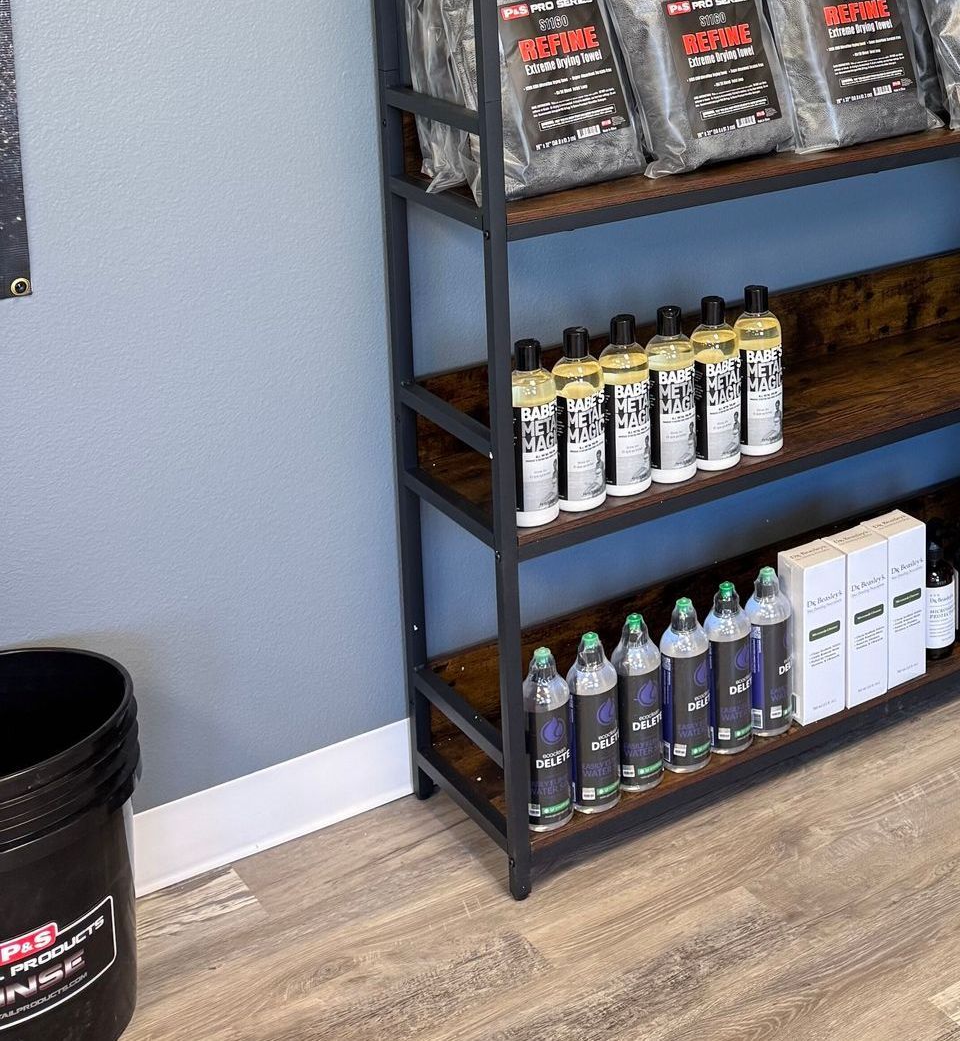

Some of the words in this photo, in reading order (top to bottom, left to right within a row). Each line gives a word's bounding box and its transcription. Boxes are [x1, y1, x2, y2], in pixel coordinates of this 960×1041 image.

[503, 6, 528, 17] P&S
[530, 2, 554, 14] PRO
[669, 2, 690, 14] P&S
[692, 0, 713, 10] PRO
[828, 26, 855, 38] Extreme
[856, 22, 876, 34] Drying
[876, 19, 893, 30] Towel
[518, 26, 599, 62] REFINE
[682, 24, 752, 55] REFINE
[525, 60, 556, 76] Extreme
[557, 53, 580, 69] Drying
[581, 50, 602, 64] Towel
[688, 53, 715, 68] Extreme
[715, 50, 737, 63] Drying
[738, 46, 754, 57] Towel
[747, 360, 782, 378] METAL
[706, 372, 741, 392] METAL
[748, 374, 783, 392] MAGIC
[707, 383, 741, 406] MAGIC
[632, 710, 662, 731] DELETE
[536, 749, 570, 769] DELETE
[1, 930, 52, 962] P&S
[10, 915, 105, 976] PRODUCTS
